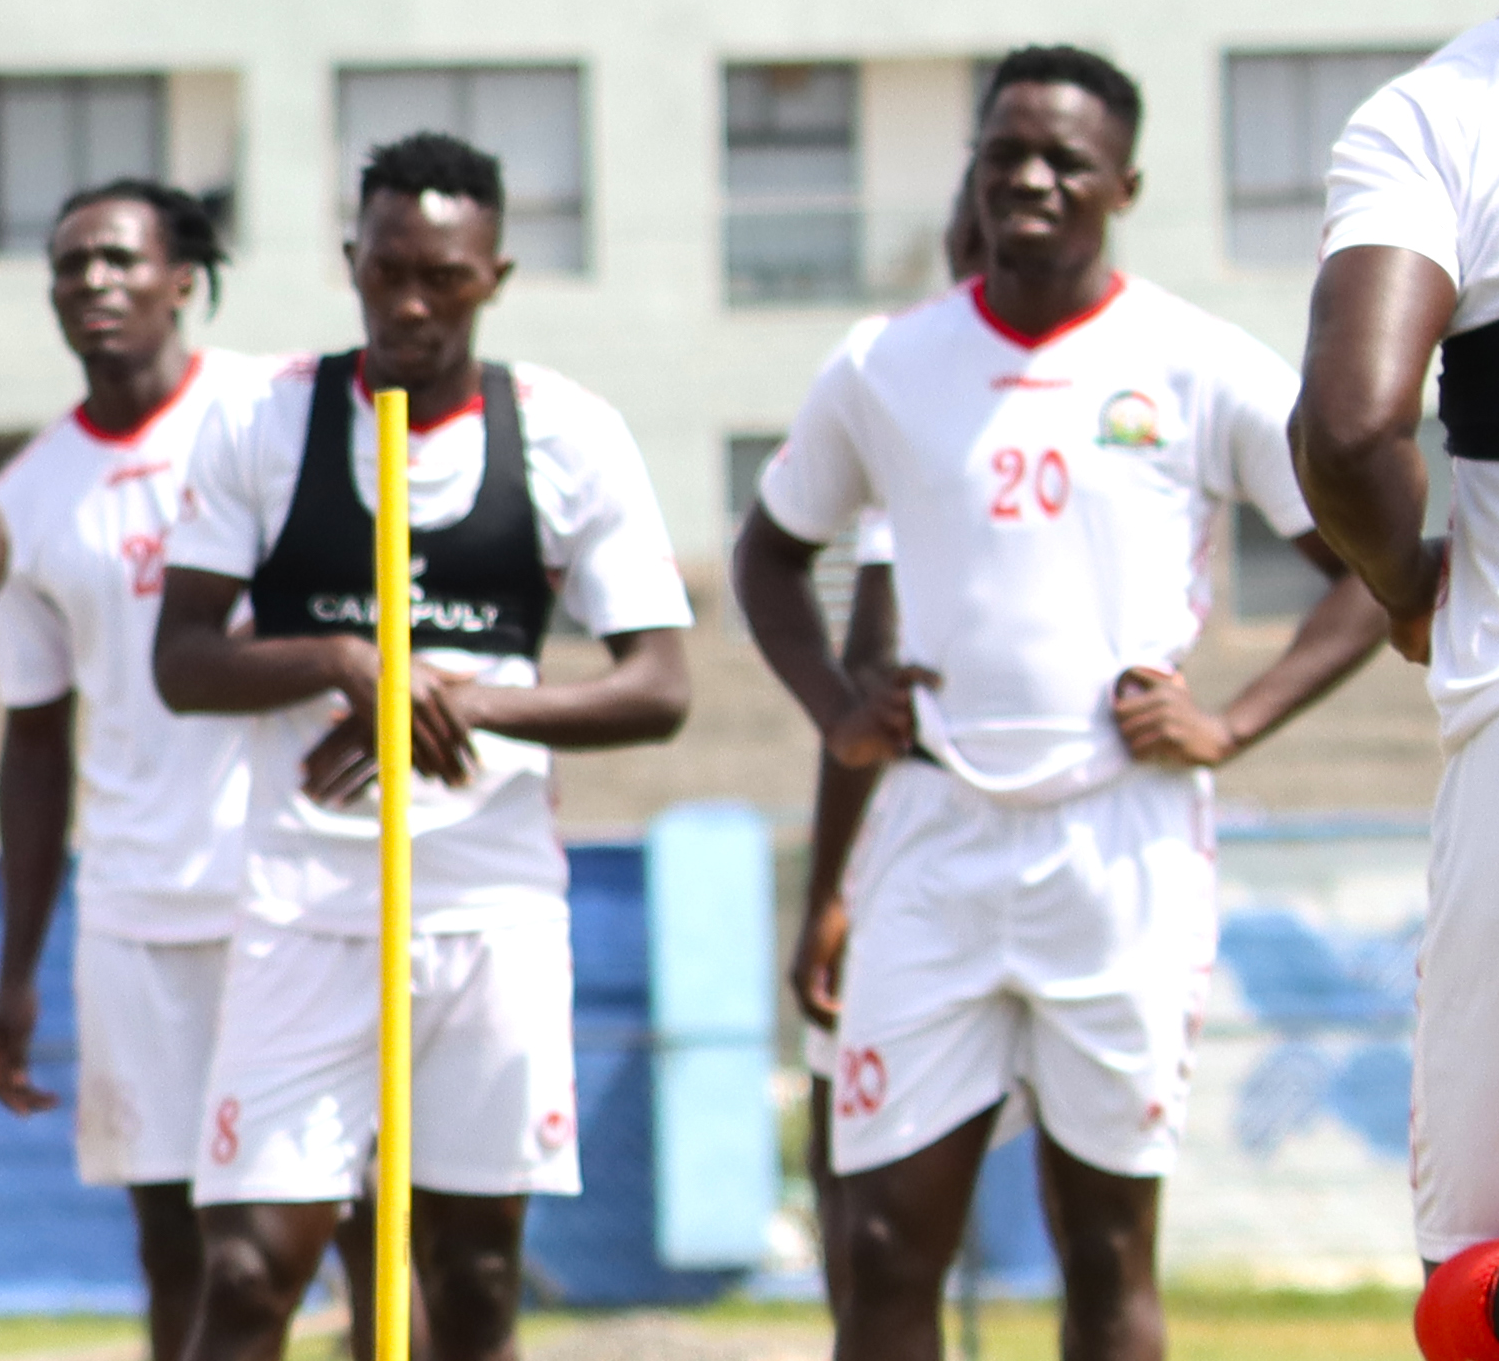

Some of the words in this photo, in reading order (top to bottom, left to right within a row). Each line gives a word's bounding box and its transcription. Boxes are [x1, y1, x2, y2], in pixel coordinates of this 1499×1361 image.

[991, 447, 1071, 519] 20
[841, 1048, 888, 1117] 20
[211, 1096, 240, 1167] 8
